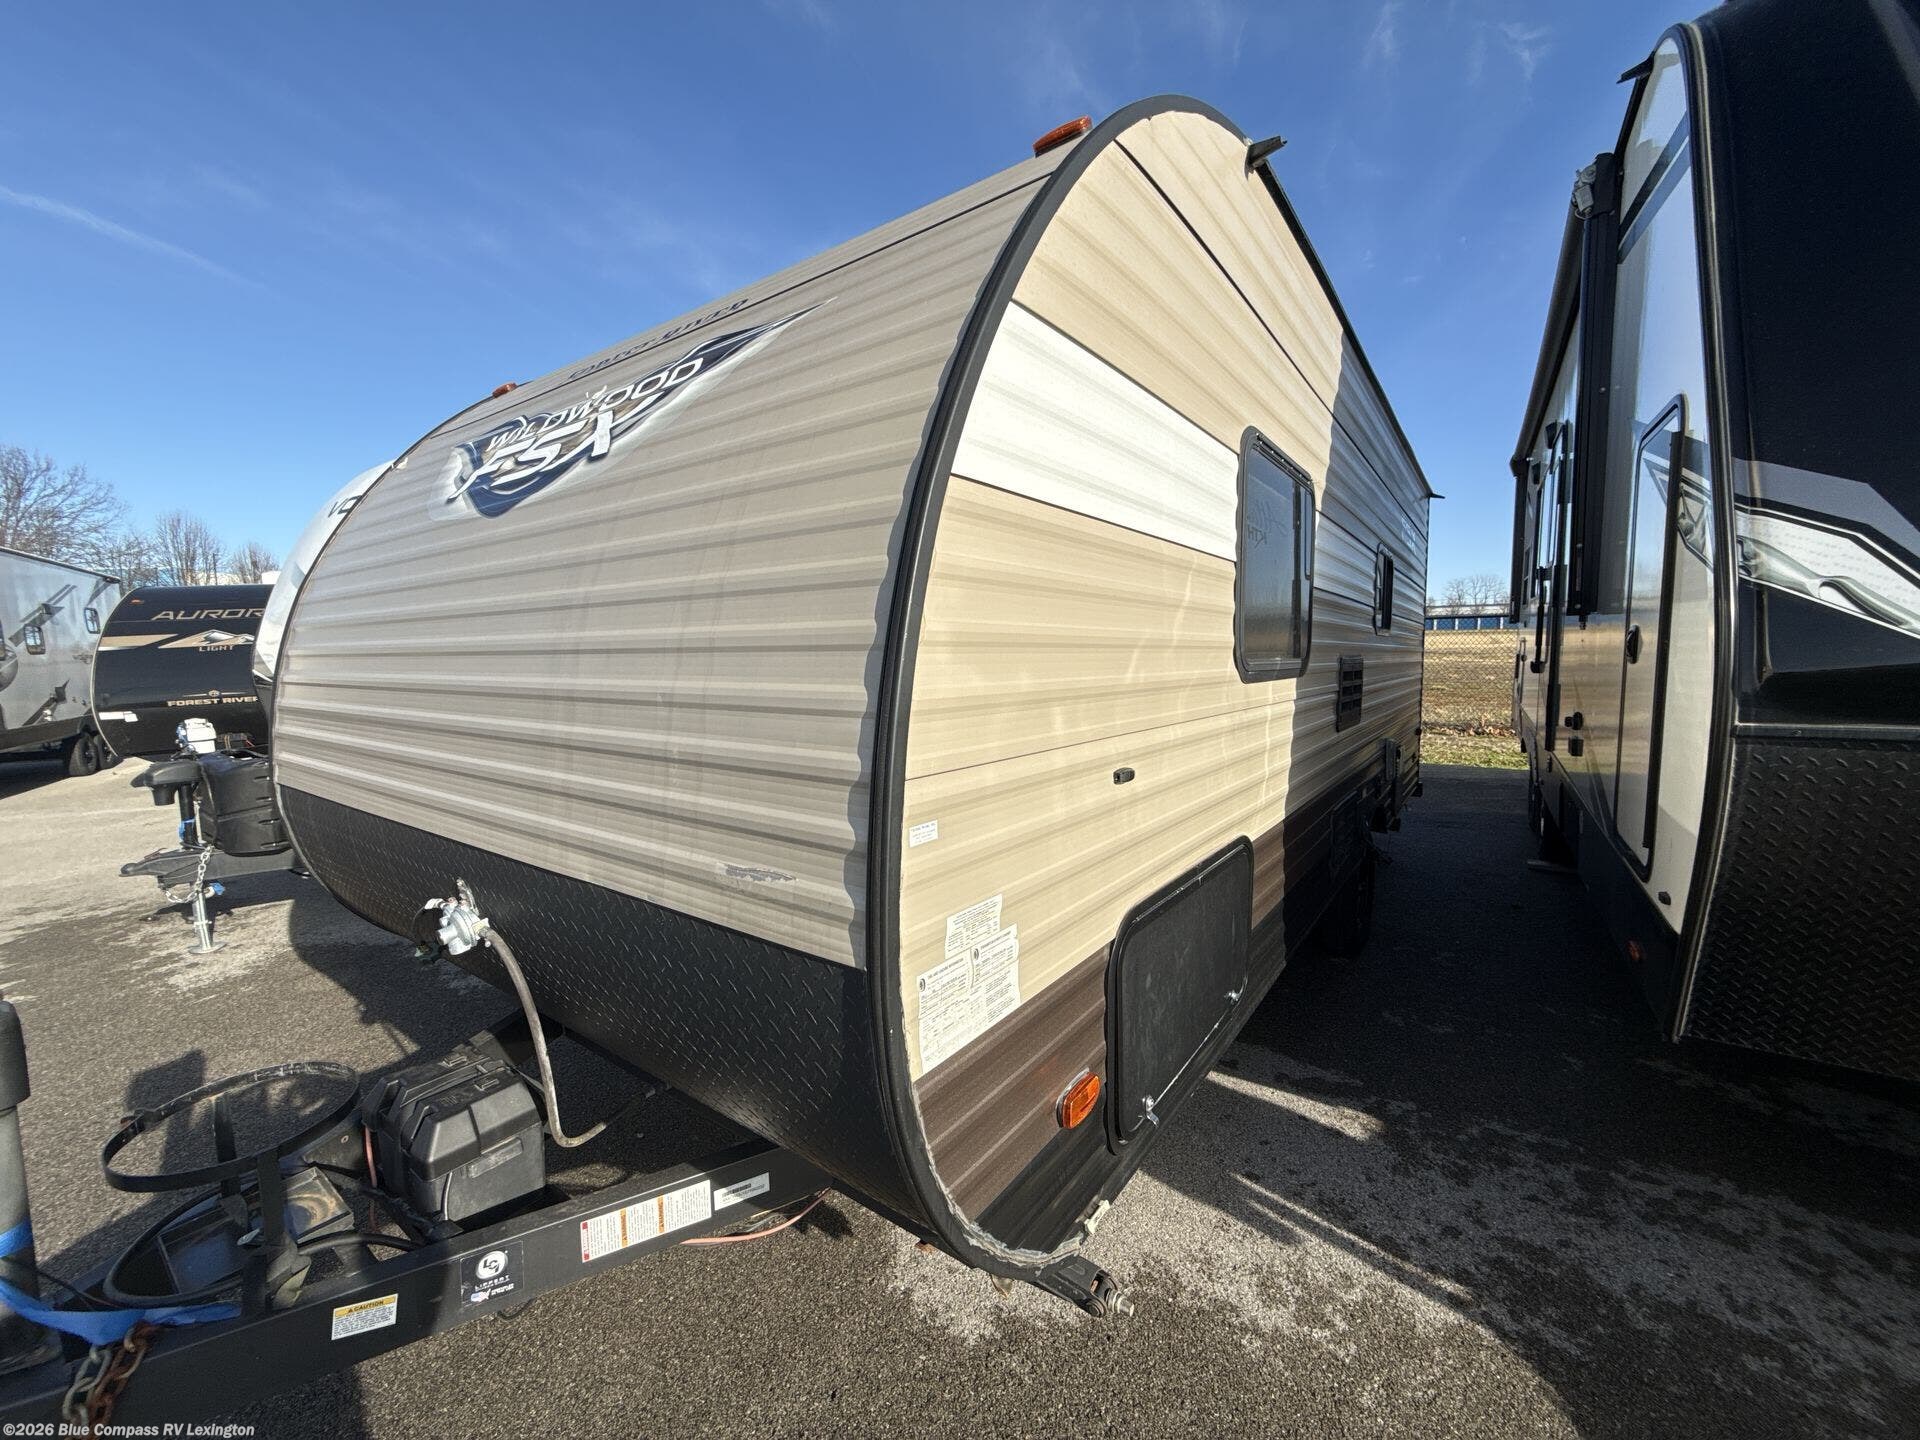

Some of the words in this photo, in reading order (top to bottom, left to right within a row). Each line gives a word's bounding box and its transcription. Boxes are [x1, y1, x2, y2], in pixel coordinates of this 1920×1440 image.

[198, 644, 235, 652] LIGHT
[166, 698, 220, 707] FOREST
[353, 1300, 385, 1313] CAUTION
